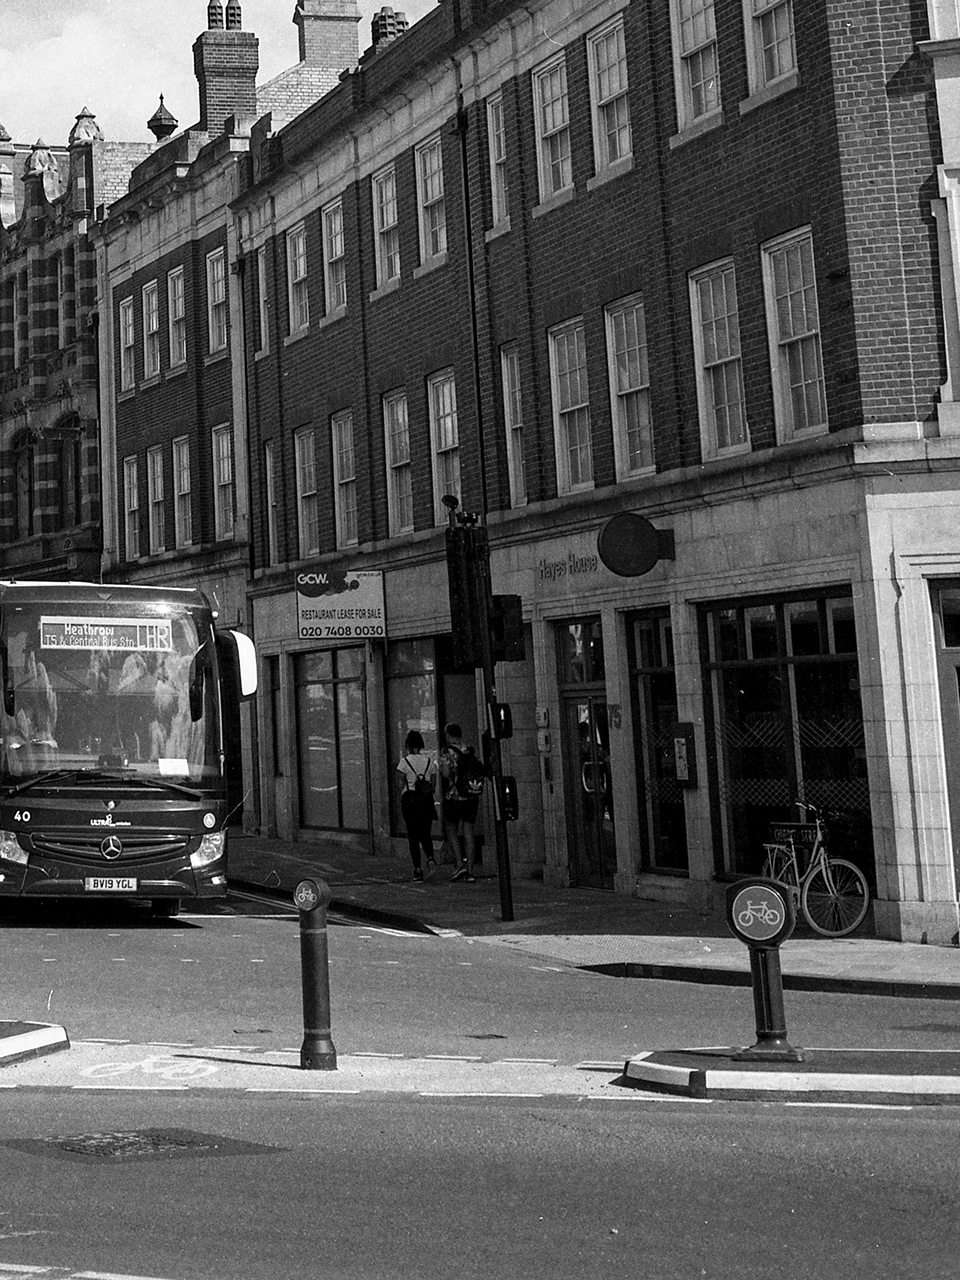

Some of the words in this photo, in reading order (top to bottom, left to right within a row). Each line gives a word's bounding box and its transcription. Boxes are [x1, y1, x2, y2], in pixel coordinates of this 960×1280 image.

[540, 559, 567, 581] Hayes
[568, 554, 598, 575] House
[301, 609, 337, 620] RESTAURANT
[338, 609, 355, 620] LEASE
[355, 608, 366, 619] FOR
[367, 608, 382, 619] SALE
[64, 623, 115, 636] Heathrow
[137, 624, 169, 649] LHR
[301, 626, 322, 637] 020
[324, 626, 352, 637] 7408
[354, 625, 384, 636] 0030
[45, 634, 57, 646] T5
[60, 635, 66, 646] &
[69, 635, 99, 647] Central
[102, 636, 117, 647] Bus
[120, 636, 135, 648] Stn
[14, 811, 31, 822] 40
[93, 880, 115, 889] BV19
[116, 880, 133, 889] YGL
